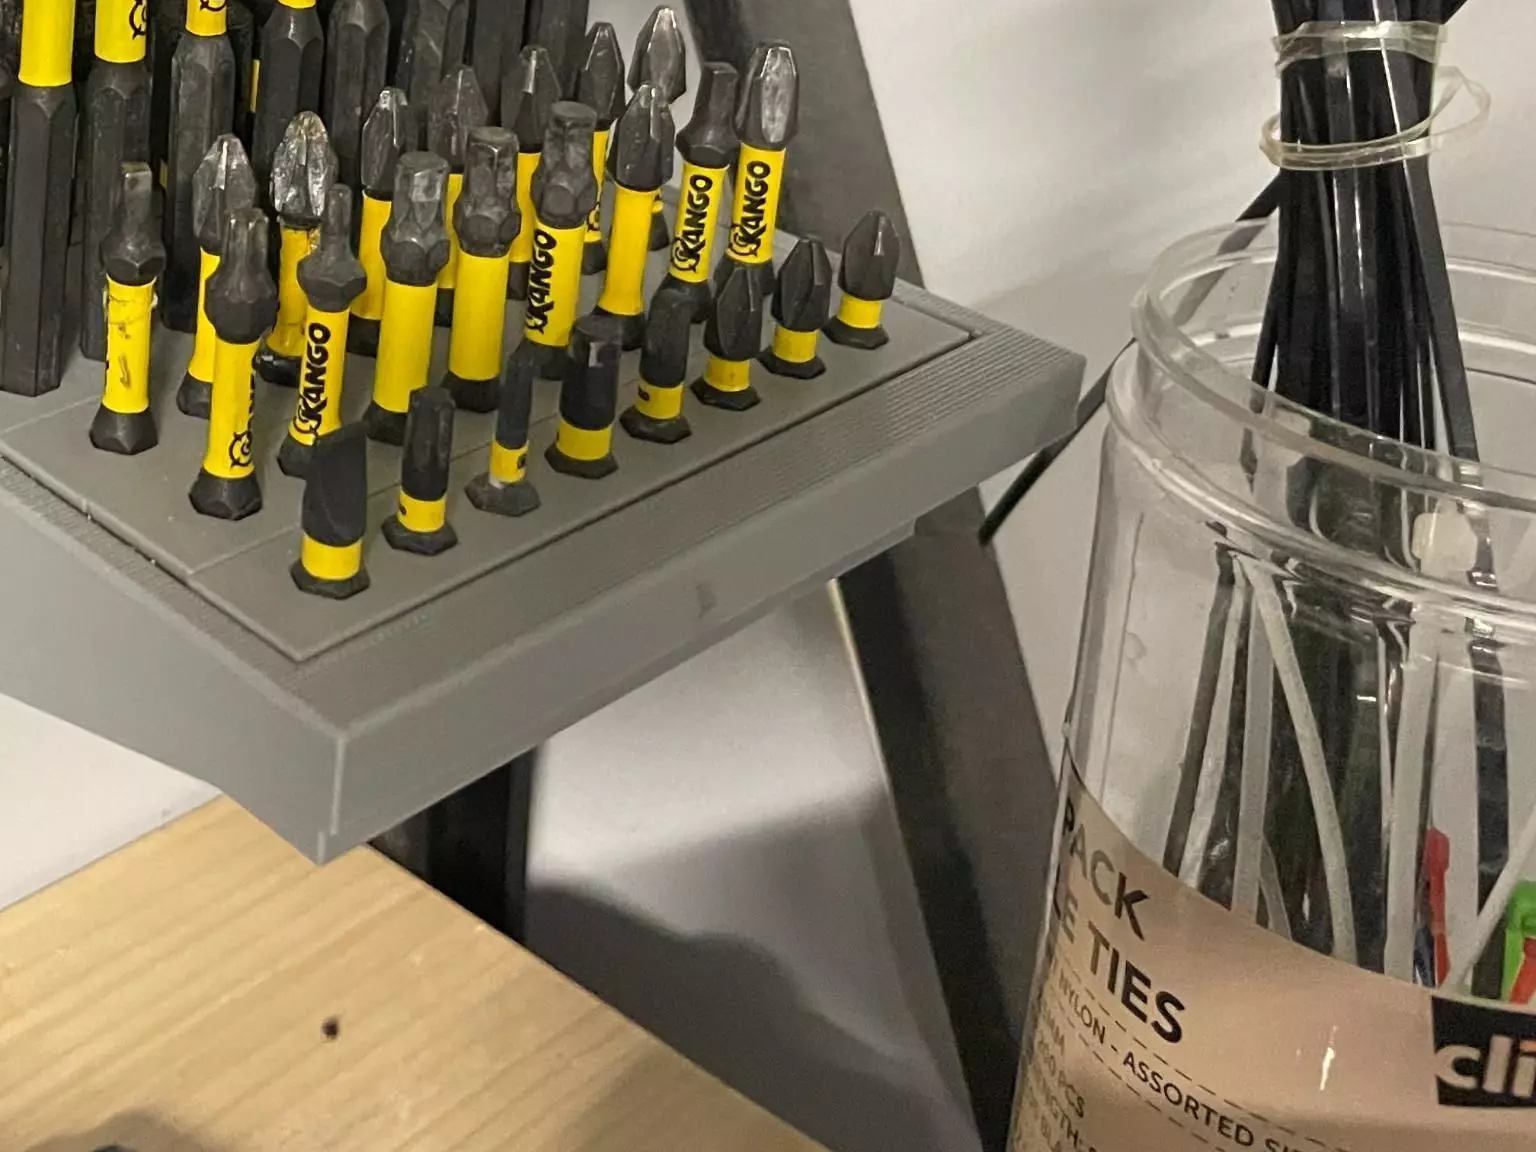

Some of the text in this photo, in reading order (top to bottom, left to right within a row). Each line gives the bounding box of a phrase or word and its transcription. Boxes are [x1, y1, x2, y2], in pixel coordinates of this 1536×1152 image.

[679, 174, 713, 256] KANGO
[740, 160, 771, 243] KANGO
[527, 229, 557, 319] KANGO
[301, 322, 331, 420] KANGO
[1088, 920, 1185, 1044] TIES
[1123, 1051, 1254, 1146] ASSORTED
